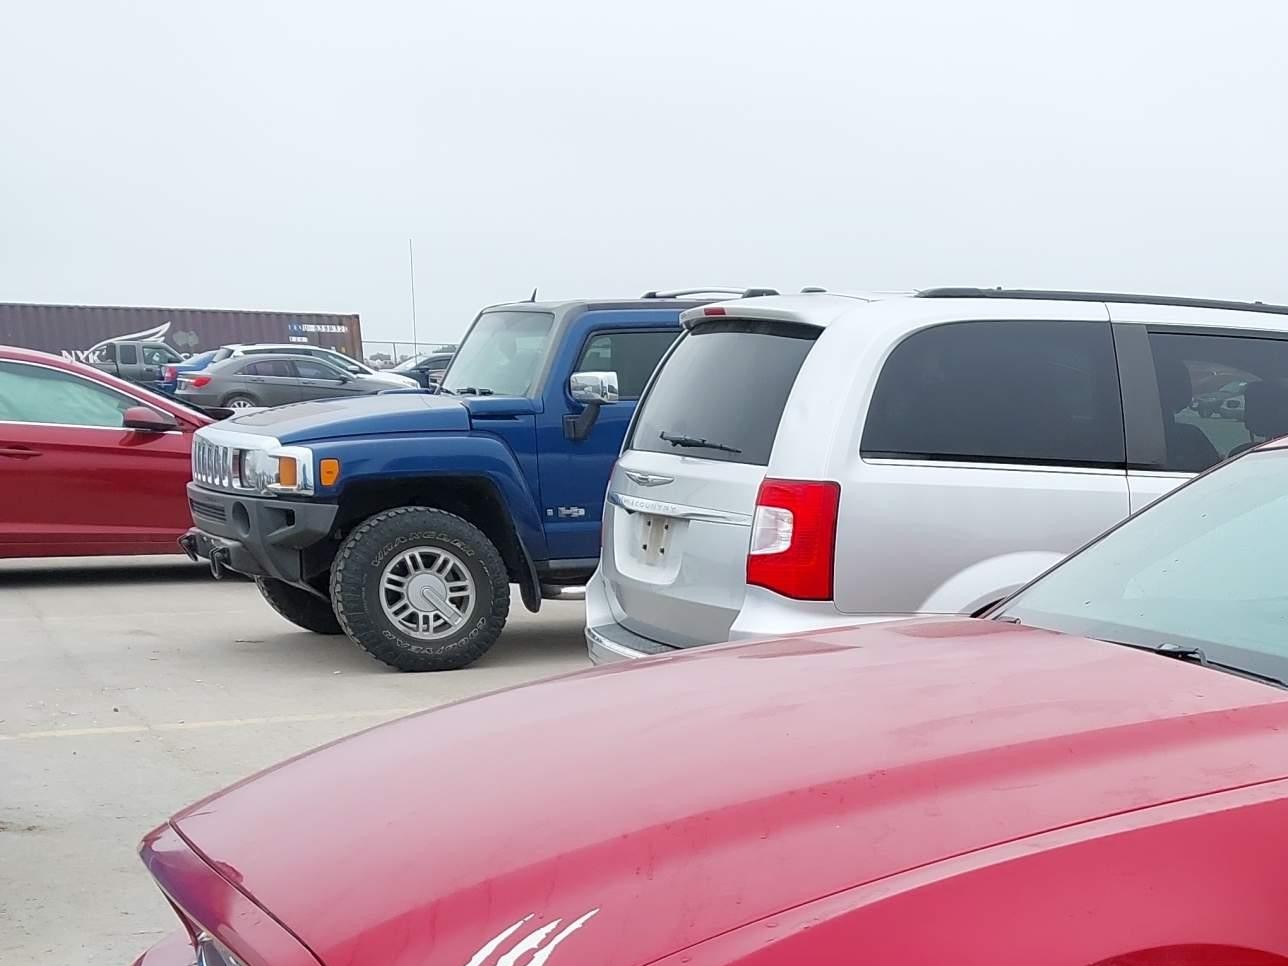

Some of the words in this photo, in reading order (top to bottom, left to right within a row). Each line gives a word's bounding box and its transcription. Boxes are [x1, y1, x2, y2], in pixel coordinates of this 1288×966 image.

[60, 350, 103, 363] NYK
[371, 531, 475, 567] WRANGLER
[382, 617, 486, 655] GOODYEAR
